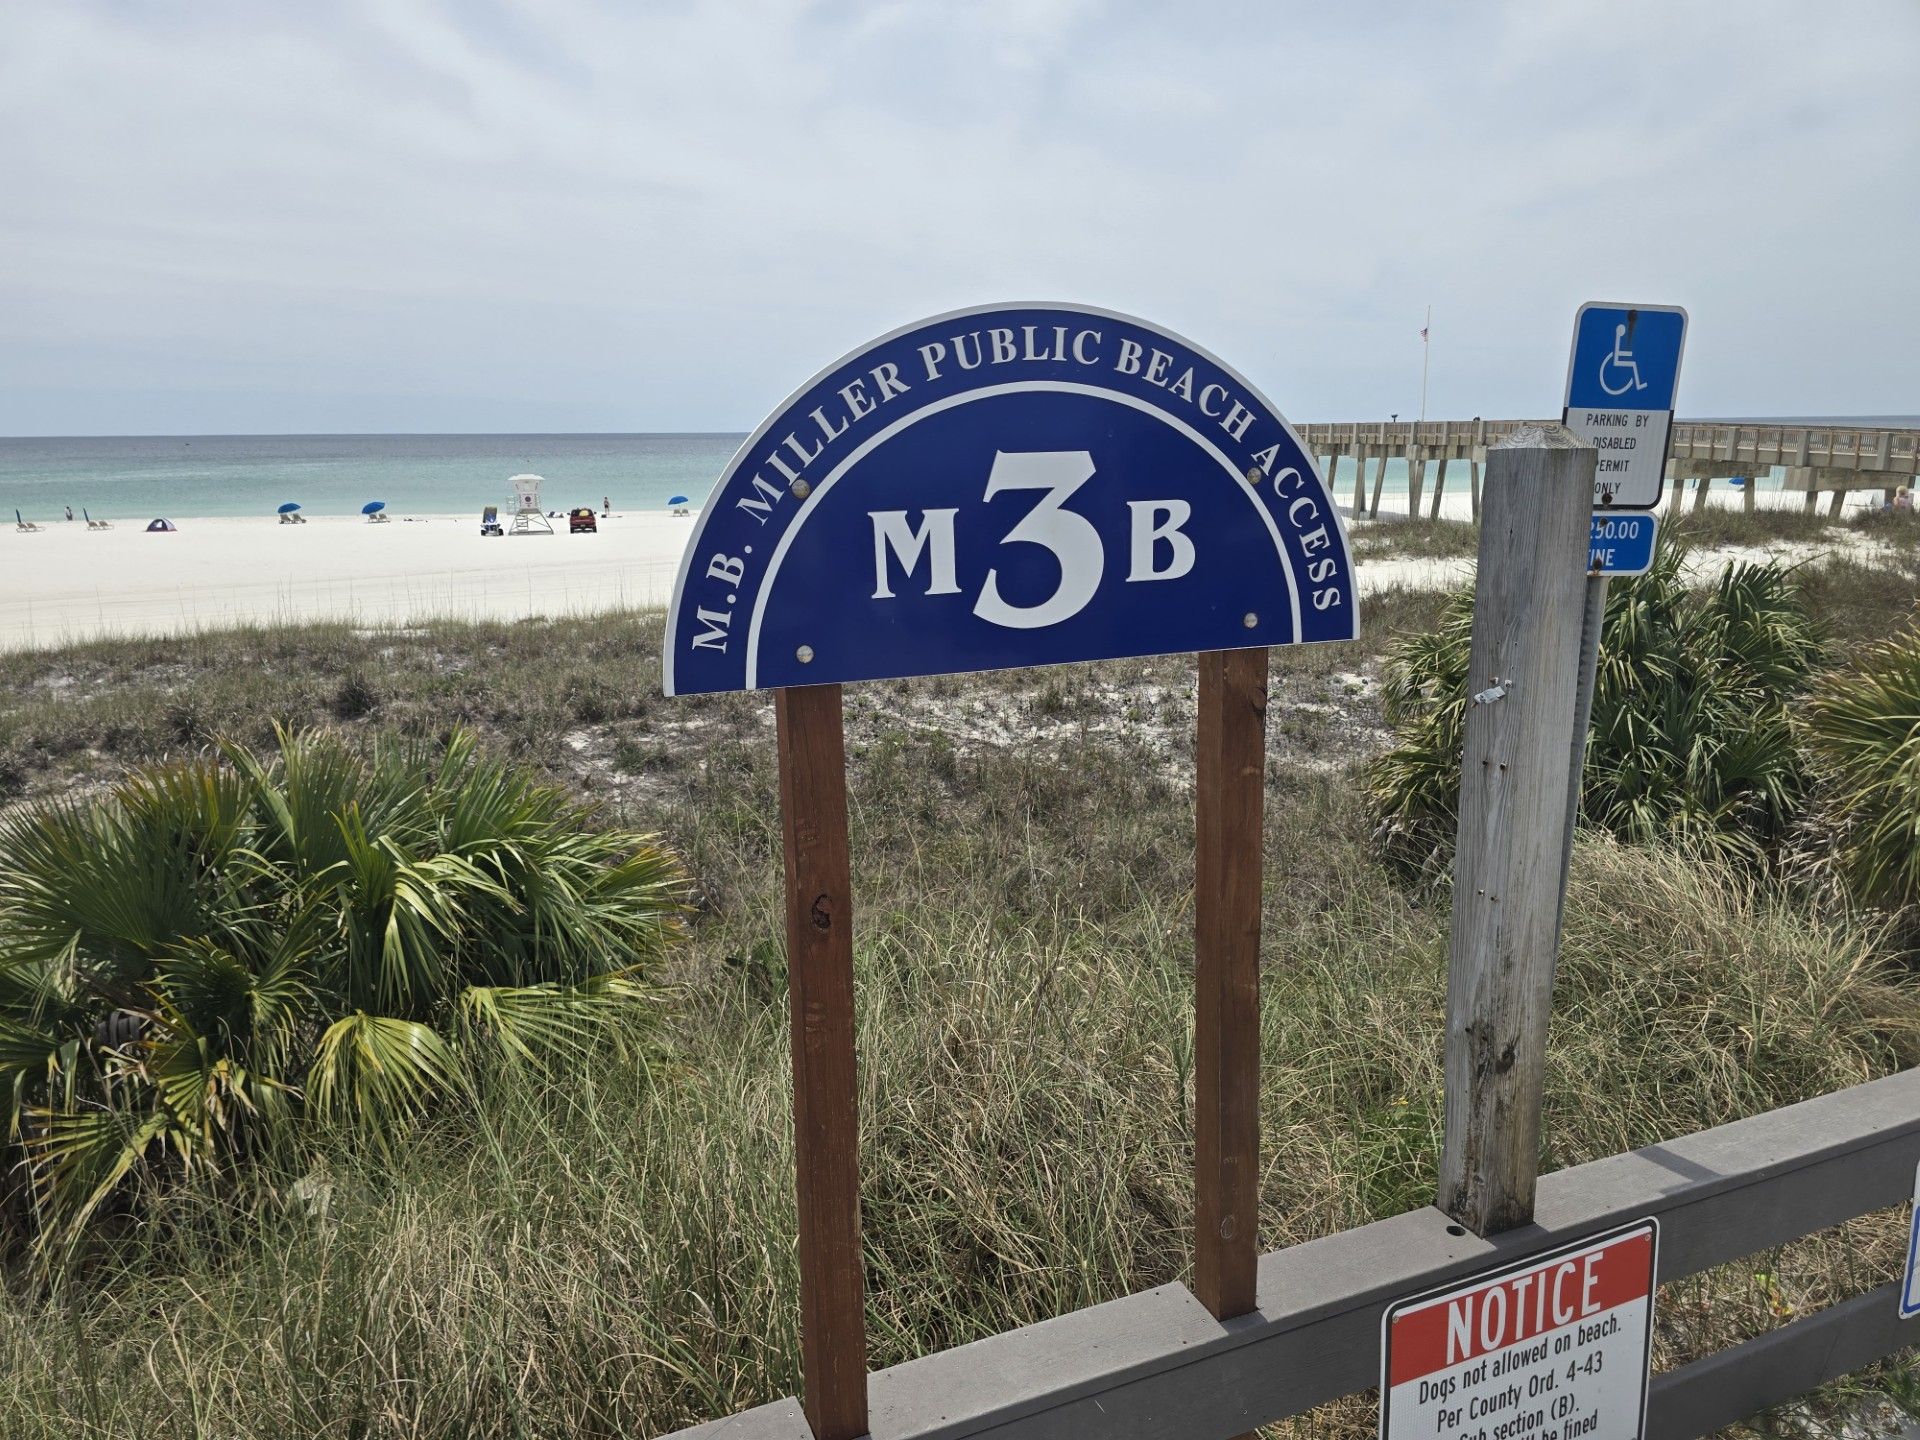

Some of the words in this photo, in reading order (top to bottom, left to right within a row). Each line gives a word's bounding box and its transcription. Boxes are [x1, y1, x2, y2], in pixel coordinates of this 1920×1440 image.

[1586, 413, 1629, 427] PARKING
[1636, 414, 1650, 428] BY
[1594, 482, 1621, 494] ONLY
[1599, 459, 1630, 472] ERMIT
[692, 545, 753, 654] M.B.
[735, 361, 912, 526] MILLER
[917, 326, 1103, 382] PUBLIC
[1113, 338, 1257, 443] BEACH
[1250, 443, 1341, 611] ACCESS
[867, 508, 962, 600] M
[972, 449, 1105, 629] 3
[1125, 499, 1196, 582] B
[1588, 548, 1616, 566] INE
[1446, 1250, 1604, 1366] NOTICE
[1419, 1376, 1456, 1405] Dogs
[1463, 1359, 1487, 1389] not
[1492, 1336, 1548, 1378] allowed
[1554, 1333, 1571, 1355] on
[1577, 1312, 1621, 1346] beach.
[1437, 1407, 1463, 1433] Per
[1469, 1384, 1522, 1420] County
[1528, 1367, 1559, 1398] Ord.
[1566, 1350, 1603, 1382] 4-43
[1493, 1409, 1544, 1440] section
[1551, 1393, 1580, 1420] (B).
[1563, 1407, 1598, 1440] fined
